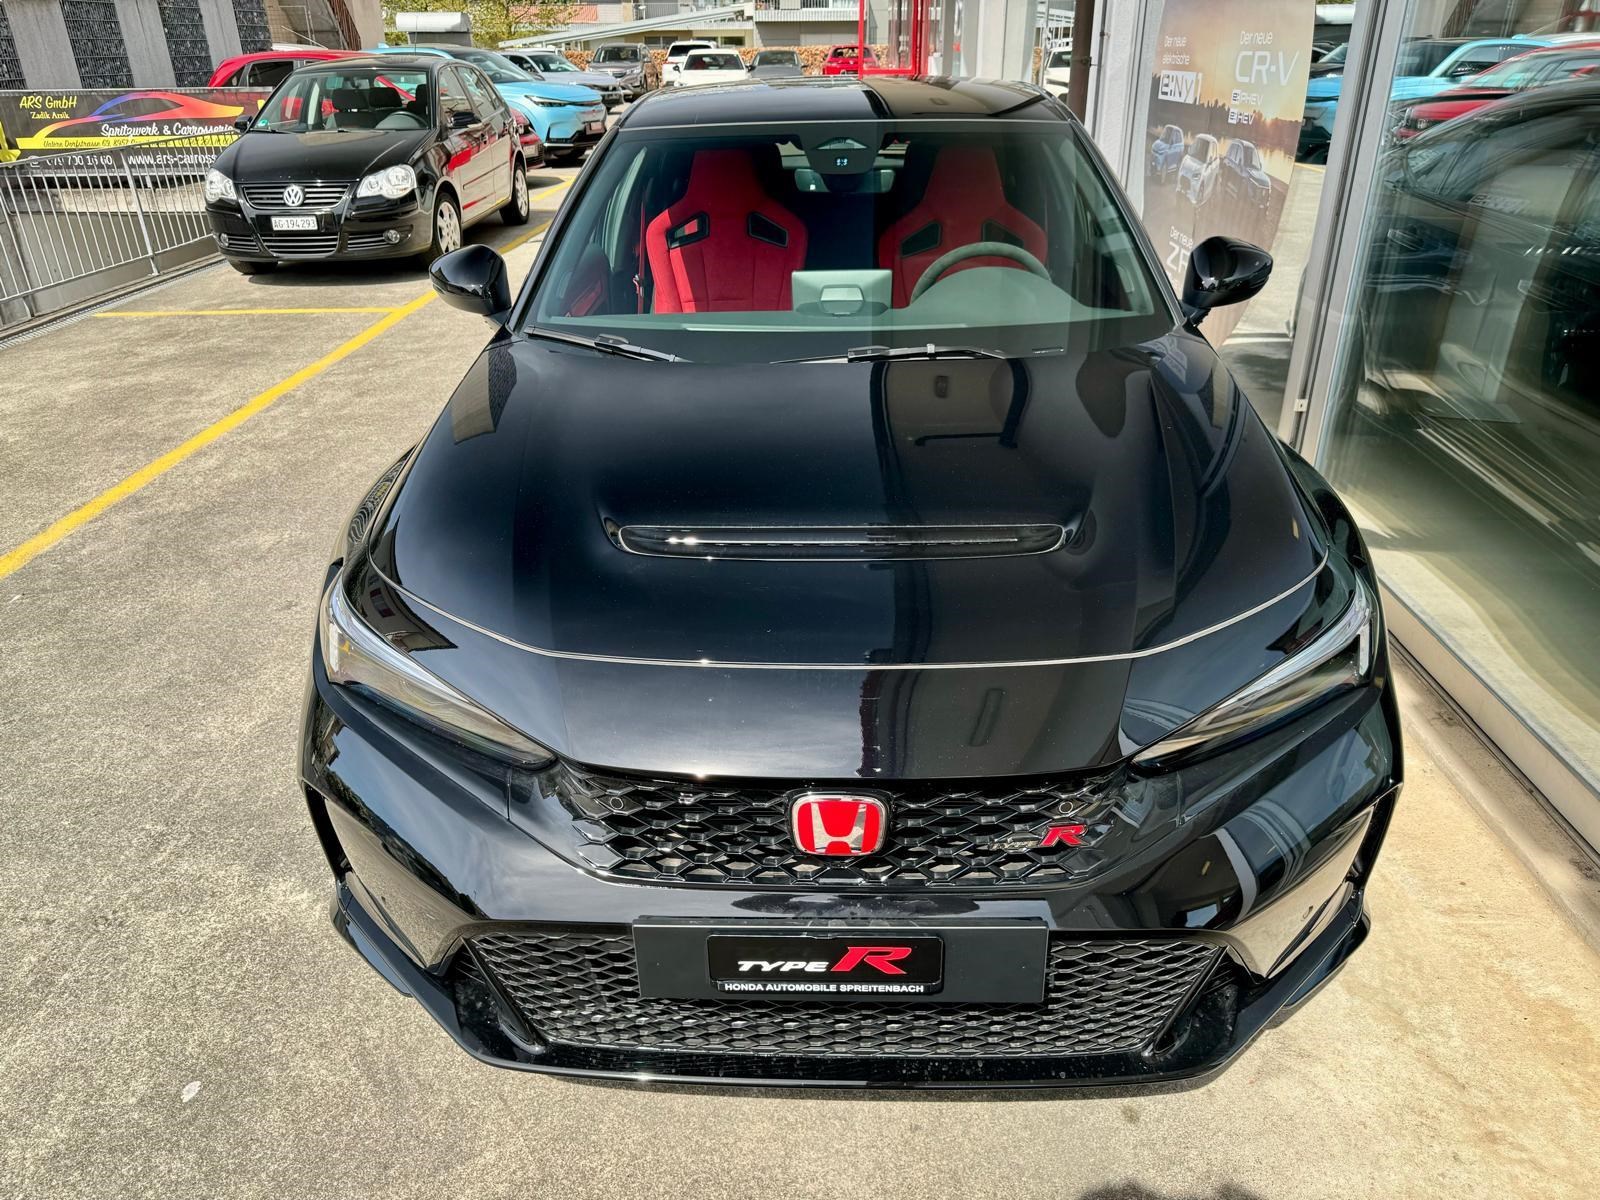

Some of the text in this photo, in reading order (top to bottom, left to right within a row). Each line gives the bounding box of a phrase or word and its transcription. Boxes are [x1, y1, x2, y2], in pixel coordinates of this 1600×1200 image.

[1240, 31, 1273, 45] Der neue
[19, 96, 77, 109] ARS GmbH
[100, 123, 160, 138] Spritzwerk
[162, 124, 172, 136] &
[1040, 824, 1091, 847] R
[738, 946, 912, 974] TYPE R
[724, 982, 925, 993] HONDA AUTOMOBILE SPREITENBACH
